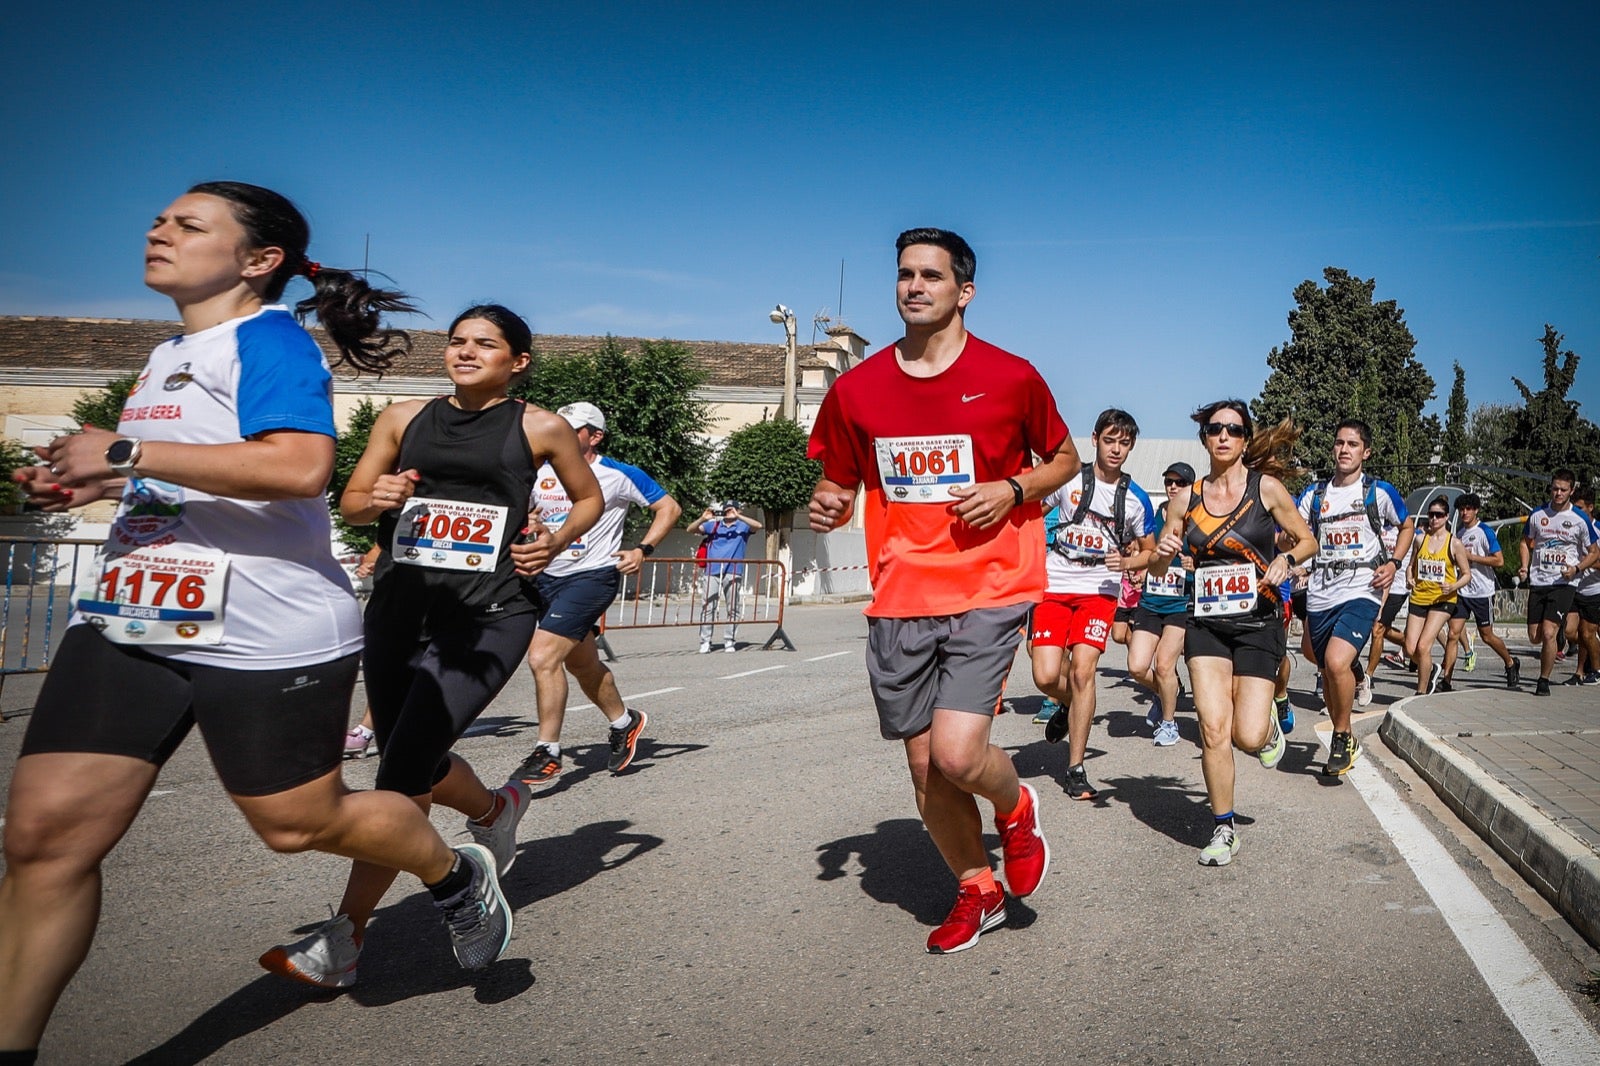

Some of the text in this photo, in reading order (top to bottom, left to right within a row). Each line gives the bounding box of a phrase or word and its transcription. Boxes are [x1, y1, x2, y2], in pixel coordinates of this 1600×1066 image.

[894, 449, 960, 476] 1061
[418, 512, 492, 544] 1062
[1067, 532, 1103, 550] 1193
[1327, 531, 1360, 545] 1031
[153, 555, 179, 565] BASE
[1545, 553, 1567, 563] 1102
[1423, 564, 1443, 574] 1105
[102, 566, 206, 609] 1176
[1204, 576, 1250, 596] 1148
